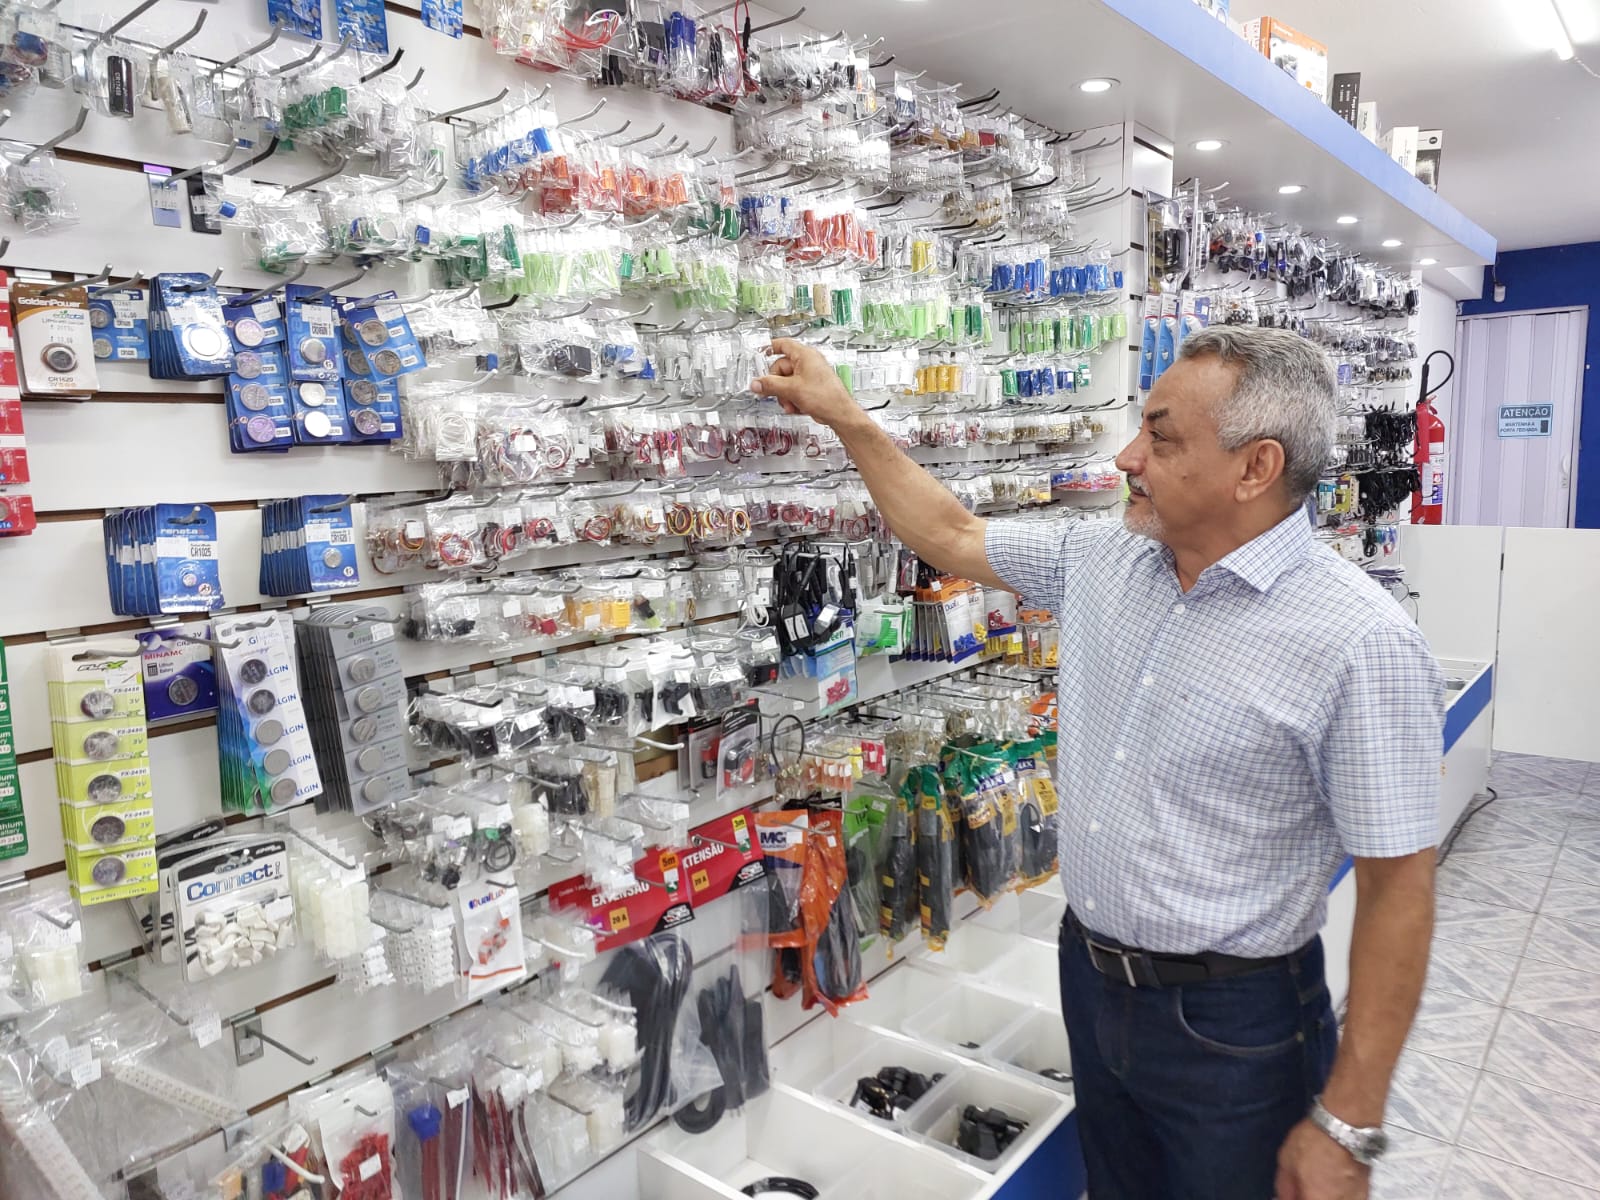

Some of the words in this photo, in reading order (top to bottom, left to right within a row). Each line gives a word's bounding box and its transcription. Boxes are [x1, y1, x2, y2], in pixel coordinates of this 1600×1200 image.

[18, 296, 80, 308] GoldenPower
[1503, 407, 1548, 418] ATENÇÃO
[160, 528, 199, 536] renata
[190, 546, 212, 557] CR1025
[275, 693, 297, 706] LGIN
[295, 783, 319, 797] ELGIN
[662, 856, 677, 867] 5m
[682, 843, 725, 869] XTENSÃO
[186, 863, 273, 901] Connect
[591, 881, 650, 908] EXNSÃO
